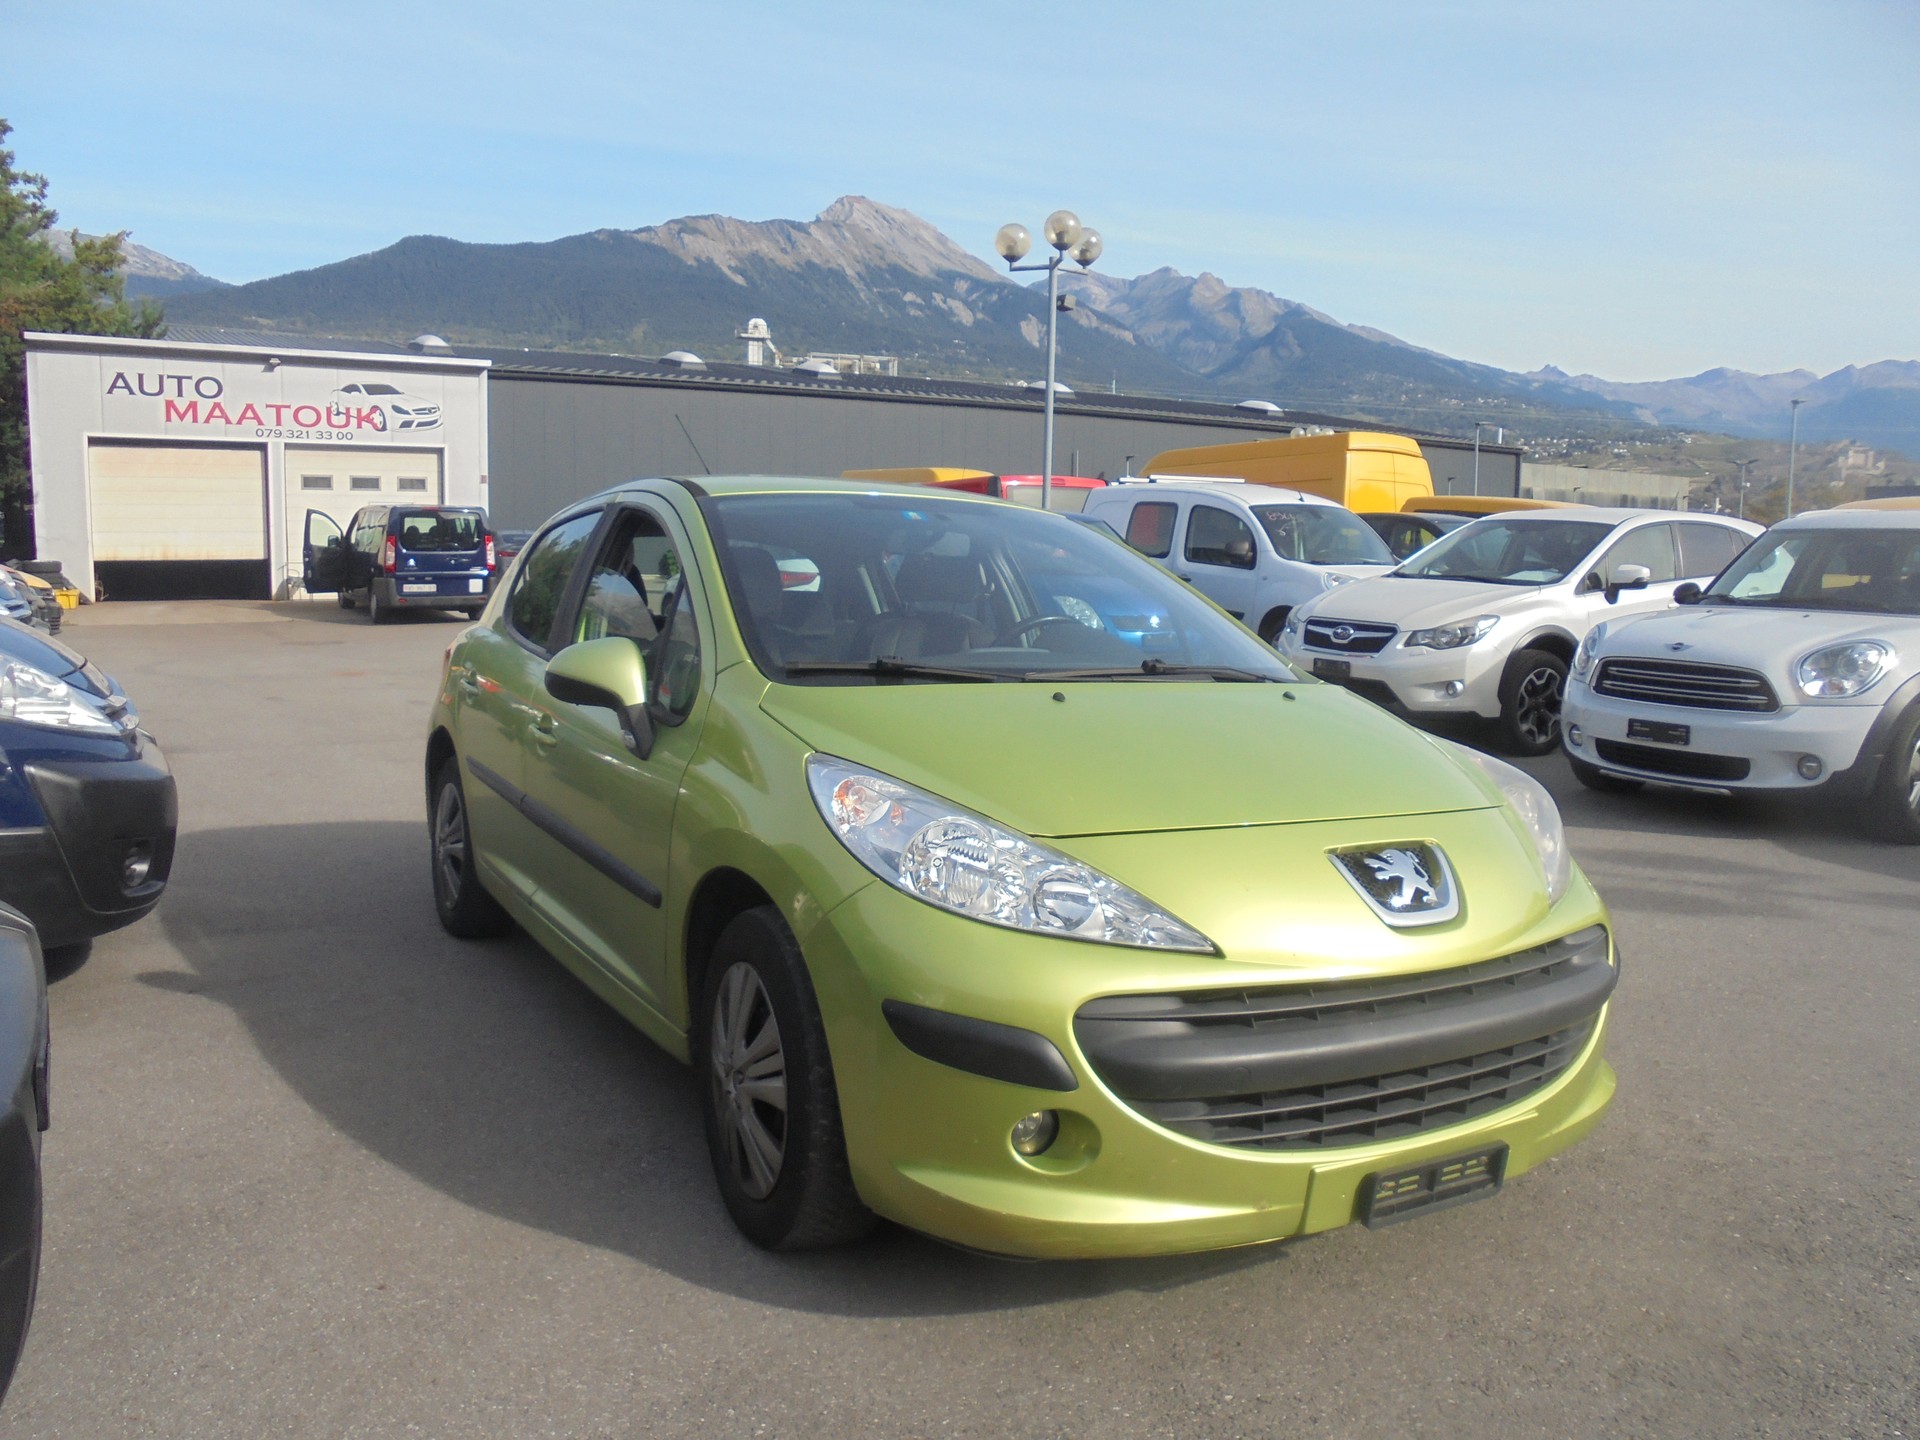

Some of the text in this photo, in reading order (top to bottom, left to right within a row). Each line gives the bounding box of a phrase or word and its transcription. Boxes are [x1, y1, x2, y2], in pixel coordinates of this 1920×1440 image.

[106, 371, 224, 400] AUTO
[164, 399, 384, 432] MAATOUK
[255, 428, 354, 441] 079 321 33 00
